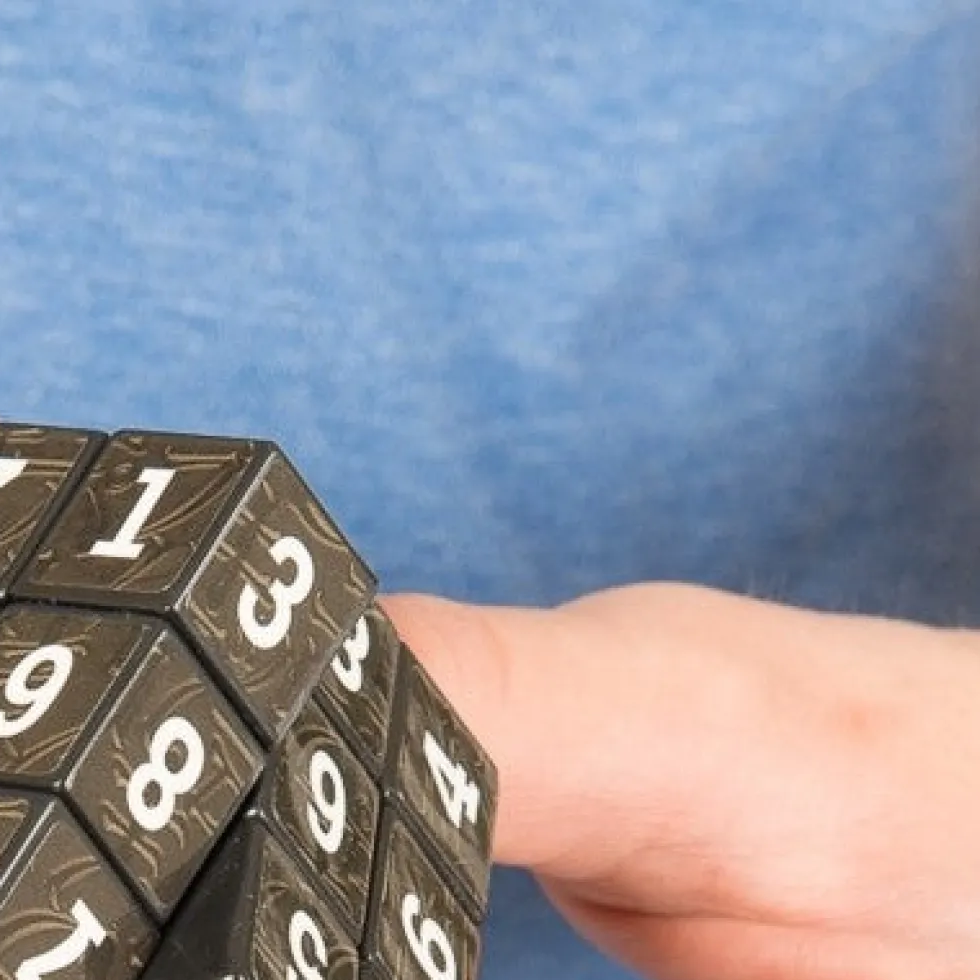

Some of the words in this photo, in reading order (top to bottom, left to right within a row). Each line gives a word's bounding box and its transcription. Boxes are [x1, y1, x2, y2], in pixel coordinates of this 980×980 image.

[88, 468, 176, 559] 1
[237, 534, 315, 650] 3
[126, 716, 205, 832] 8
[423, 730, 481, 828] 4
